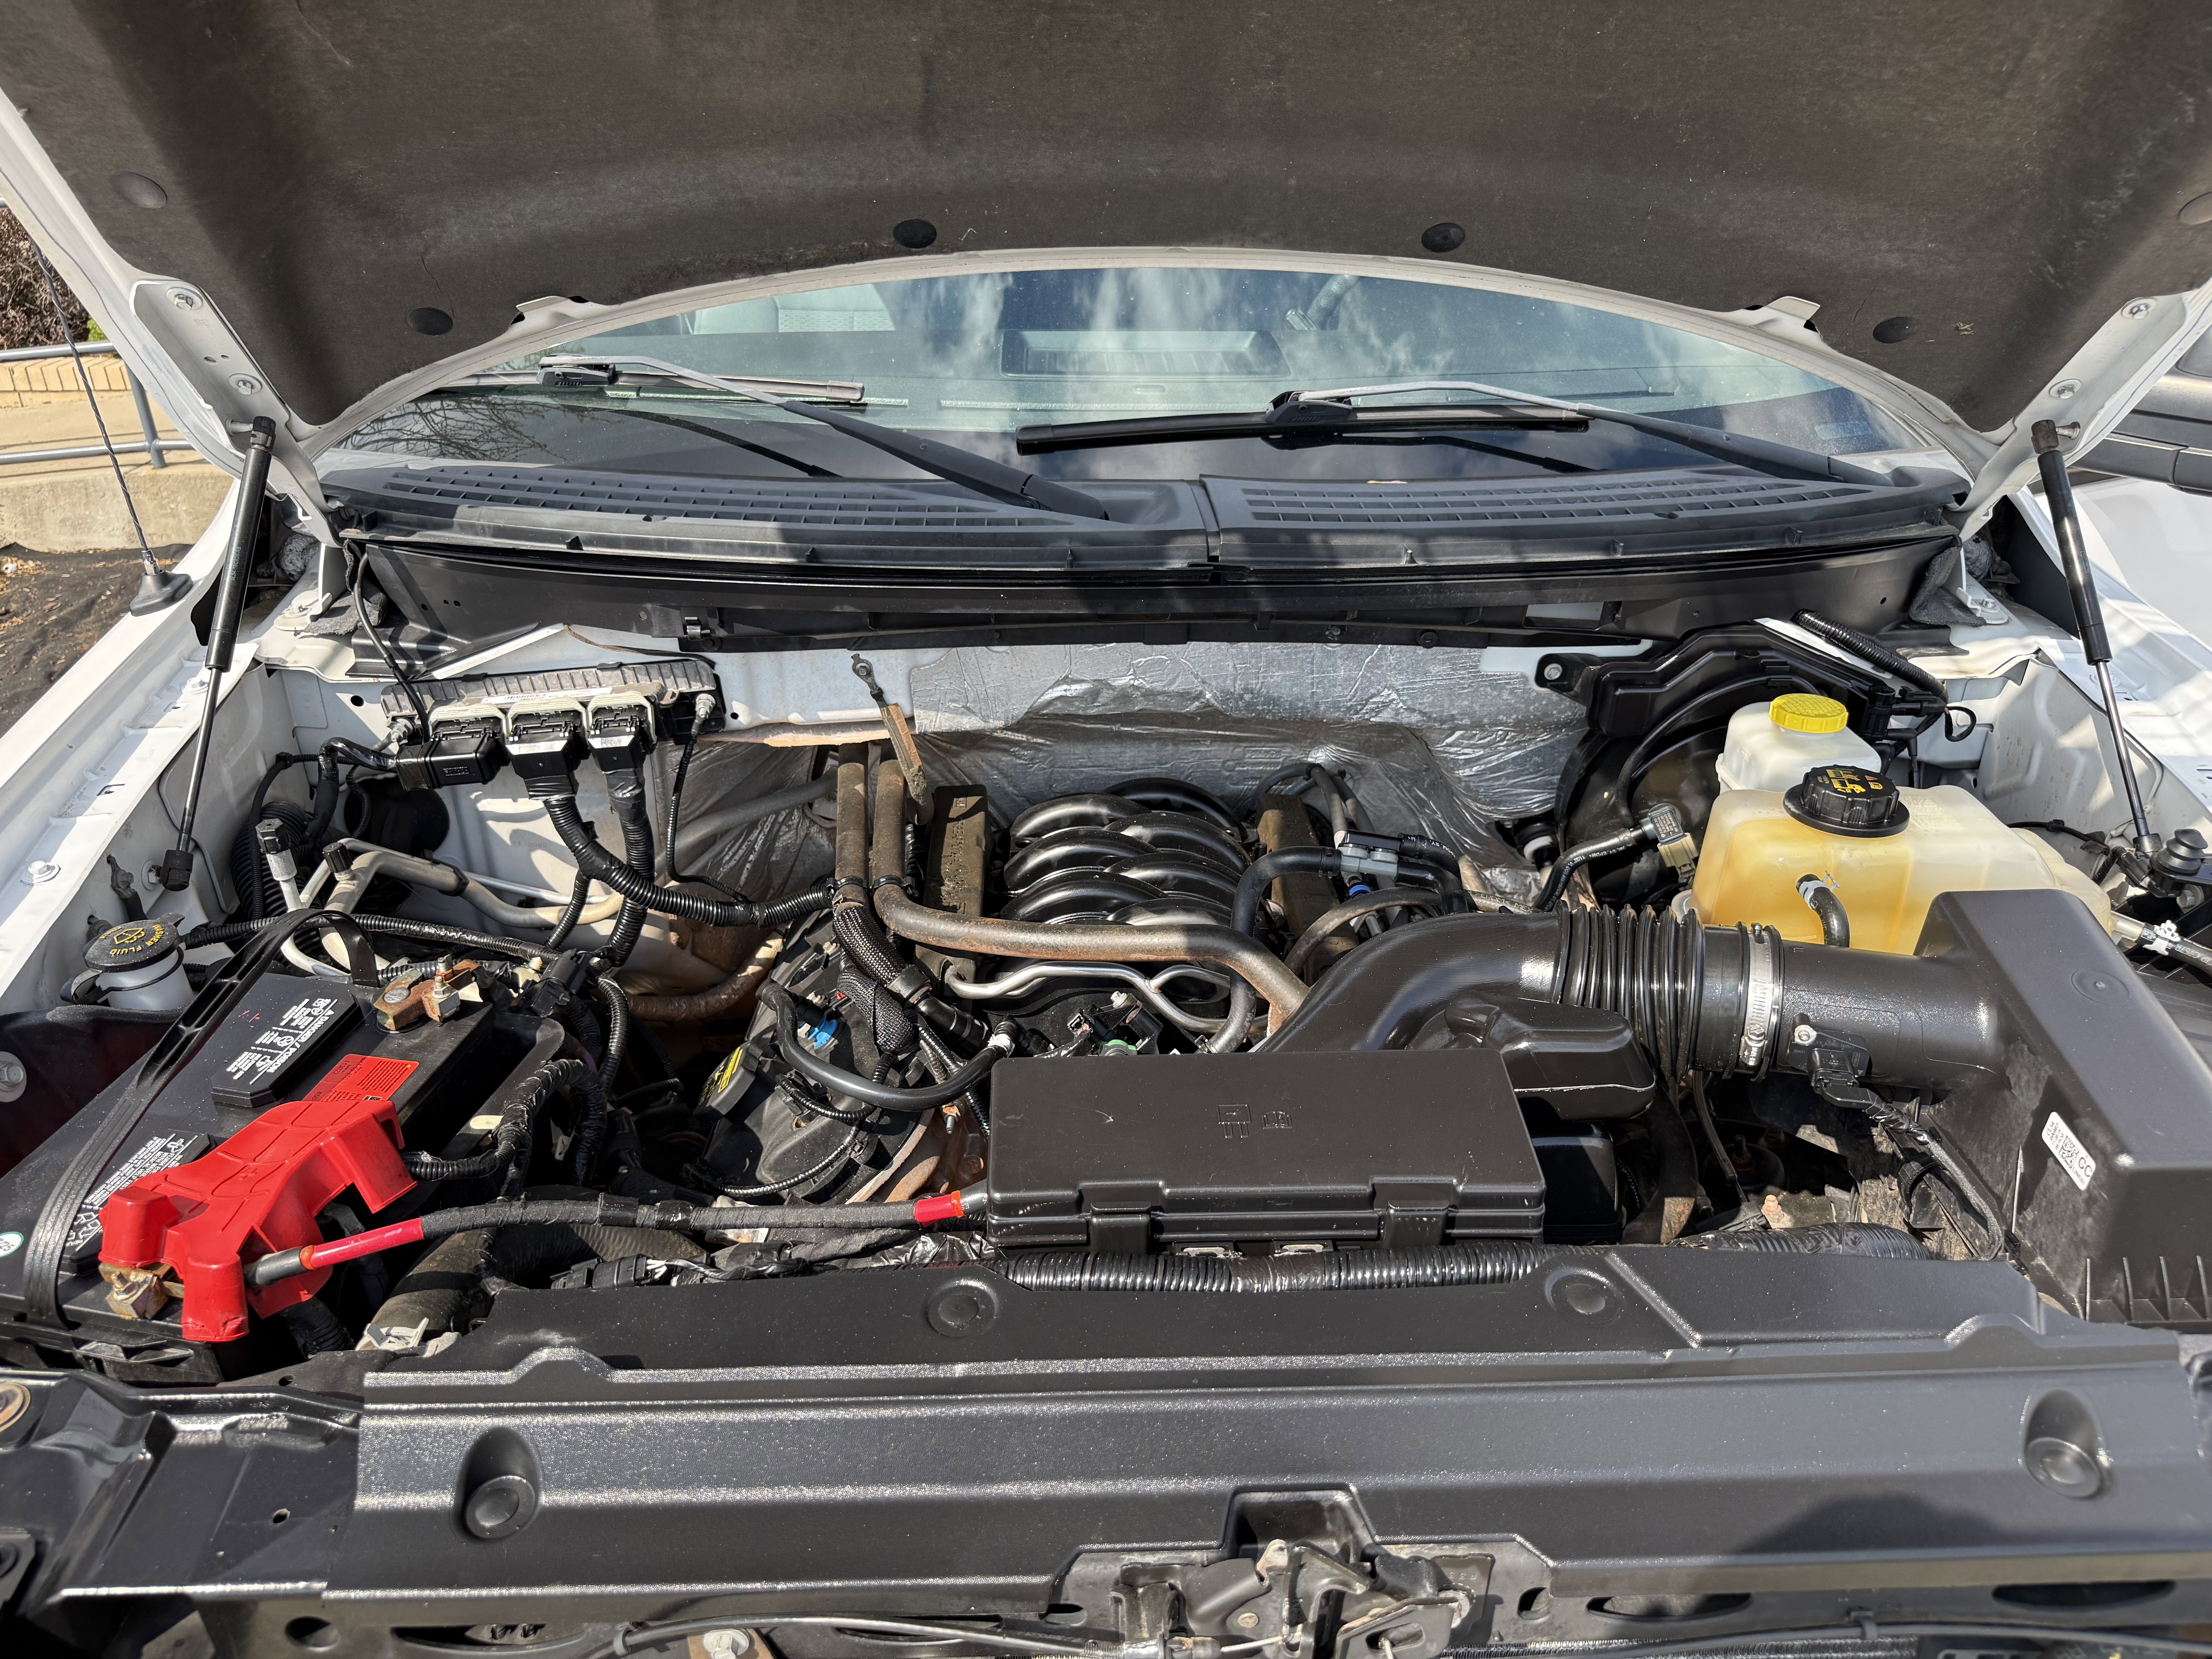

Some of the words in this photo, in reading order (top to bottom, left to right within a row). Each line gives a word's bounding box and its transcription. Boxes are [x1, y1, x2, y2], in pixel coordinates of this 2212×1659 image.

[1513, 902, 1534, 914] MEX
[145, 924, 164, 946] WASHER
[109, 945, 142, 955] FLUID
[296, 1015, 331, 1042] DANGER
[265, 1047, 298, 1073] POISON
[310, 1091, 323, 1100] 850
[141, 1151, 165, 1168] MEDICAL
[154, 1152, 170, 1162] WITH
[158, 1152, 176, 1166] FLUSH
